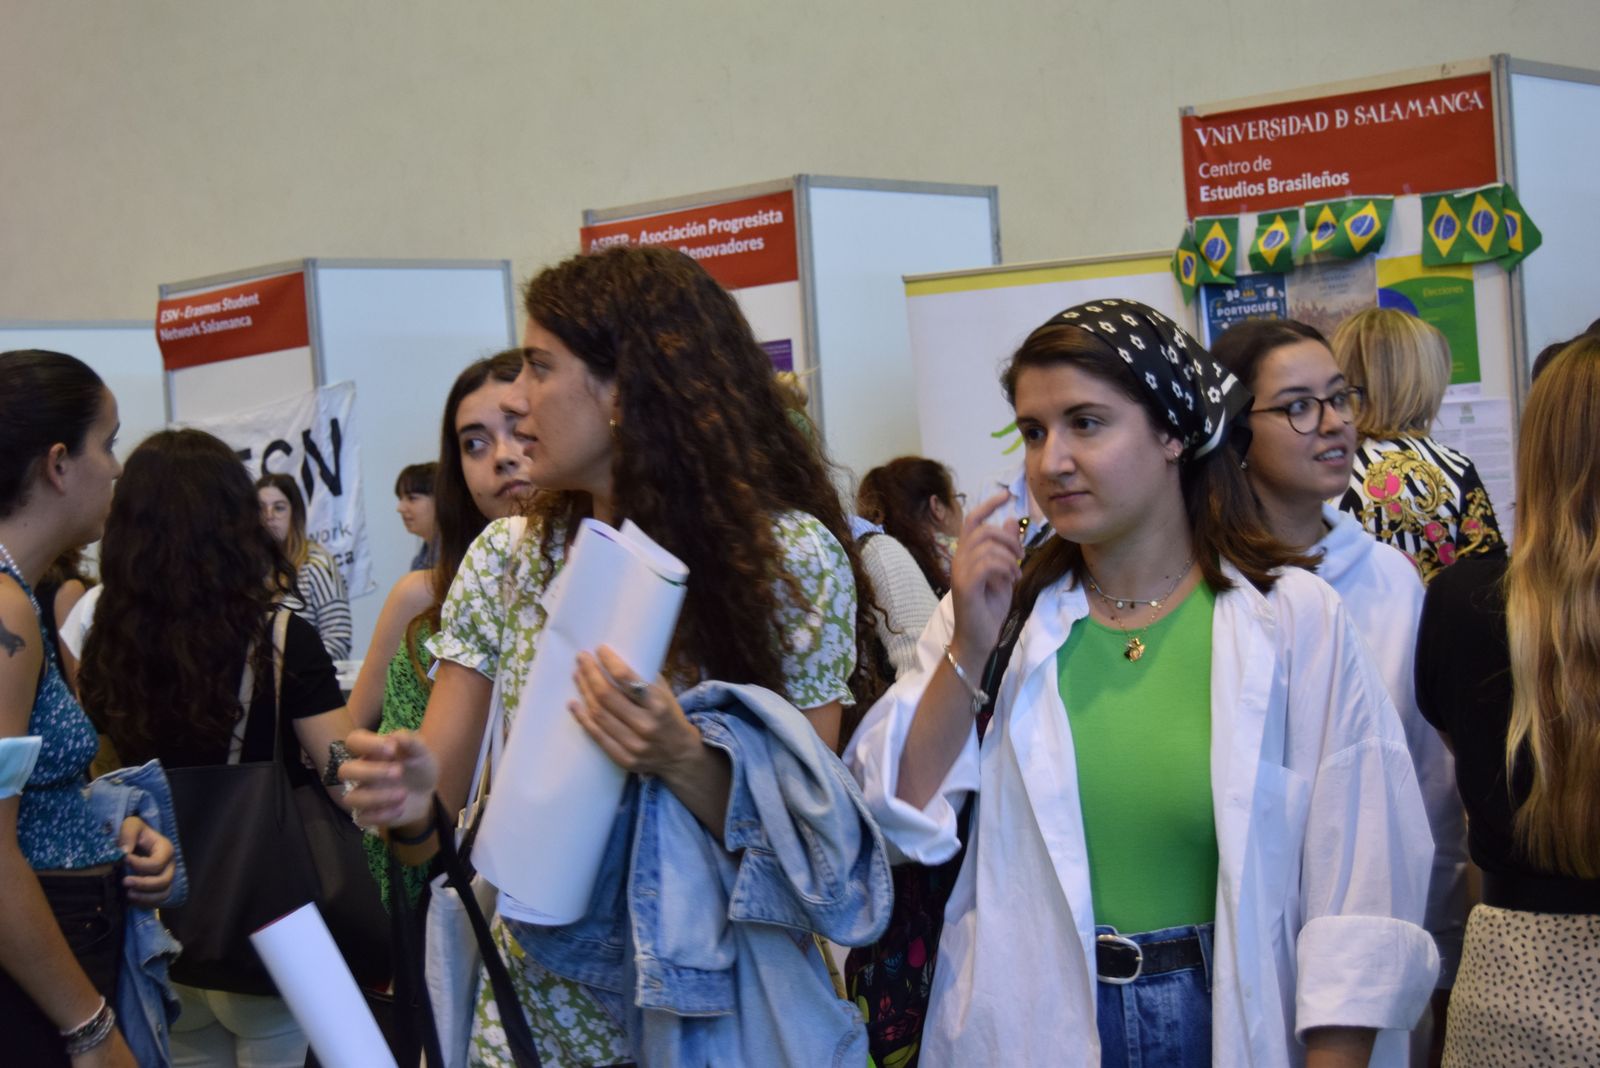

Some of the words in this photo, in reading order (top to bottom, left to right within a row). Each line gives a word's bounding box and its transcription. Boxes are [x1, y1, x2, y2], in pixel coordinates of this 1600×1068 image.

[1354, 90, 1485, 126] SALAMANCA
[1198, 160, 1251, 179] Centro
[1253, 155, 1272, 172] de
[1199, 180, 1265, 203] Estudios
[1267, 170, 1350, 195] Brasileños
[639, 221, 706, 246] Asociación
[708, 209, 783, 236] Progresista
[184, 303, 222, 319] Erasmus
[222, 293, 260, 311] Student
[160, 321, 201, 342] Network
[201, 315, 253, 335] Salamanca
